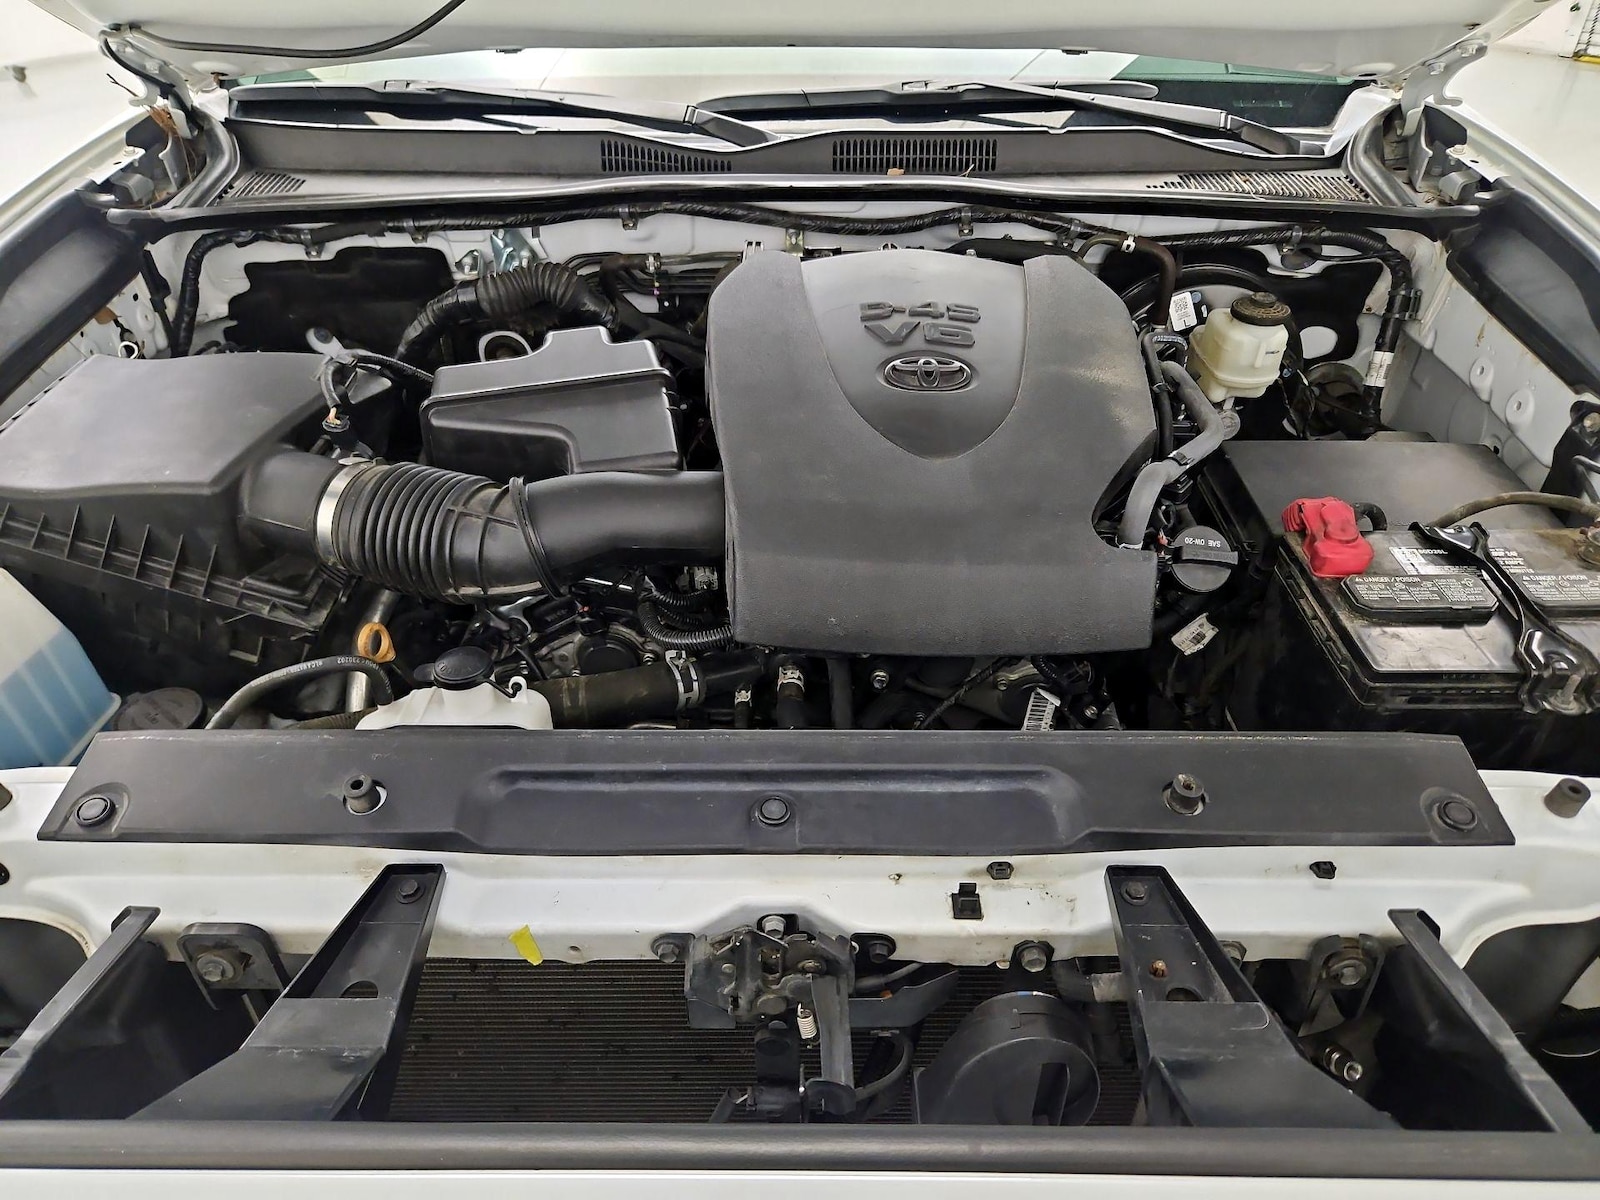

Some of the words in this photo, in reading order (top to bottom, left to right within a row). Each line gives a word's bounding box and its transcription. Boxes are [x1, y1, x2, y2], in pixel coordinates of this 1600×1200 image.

[860, 301, 981, 323] D-4S
[864, 321, 976, 347] V6
[1184, 537, 1205, 546] 0W-20
[1207, 540, 1221, 548] SAE
